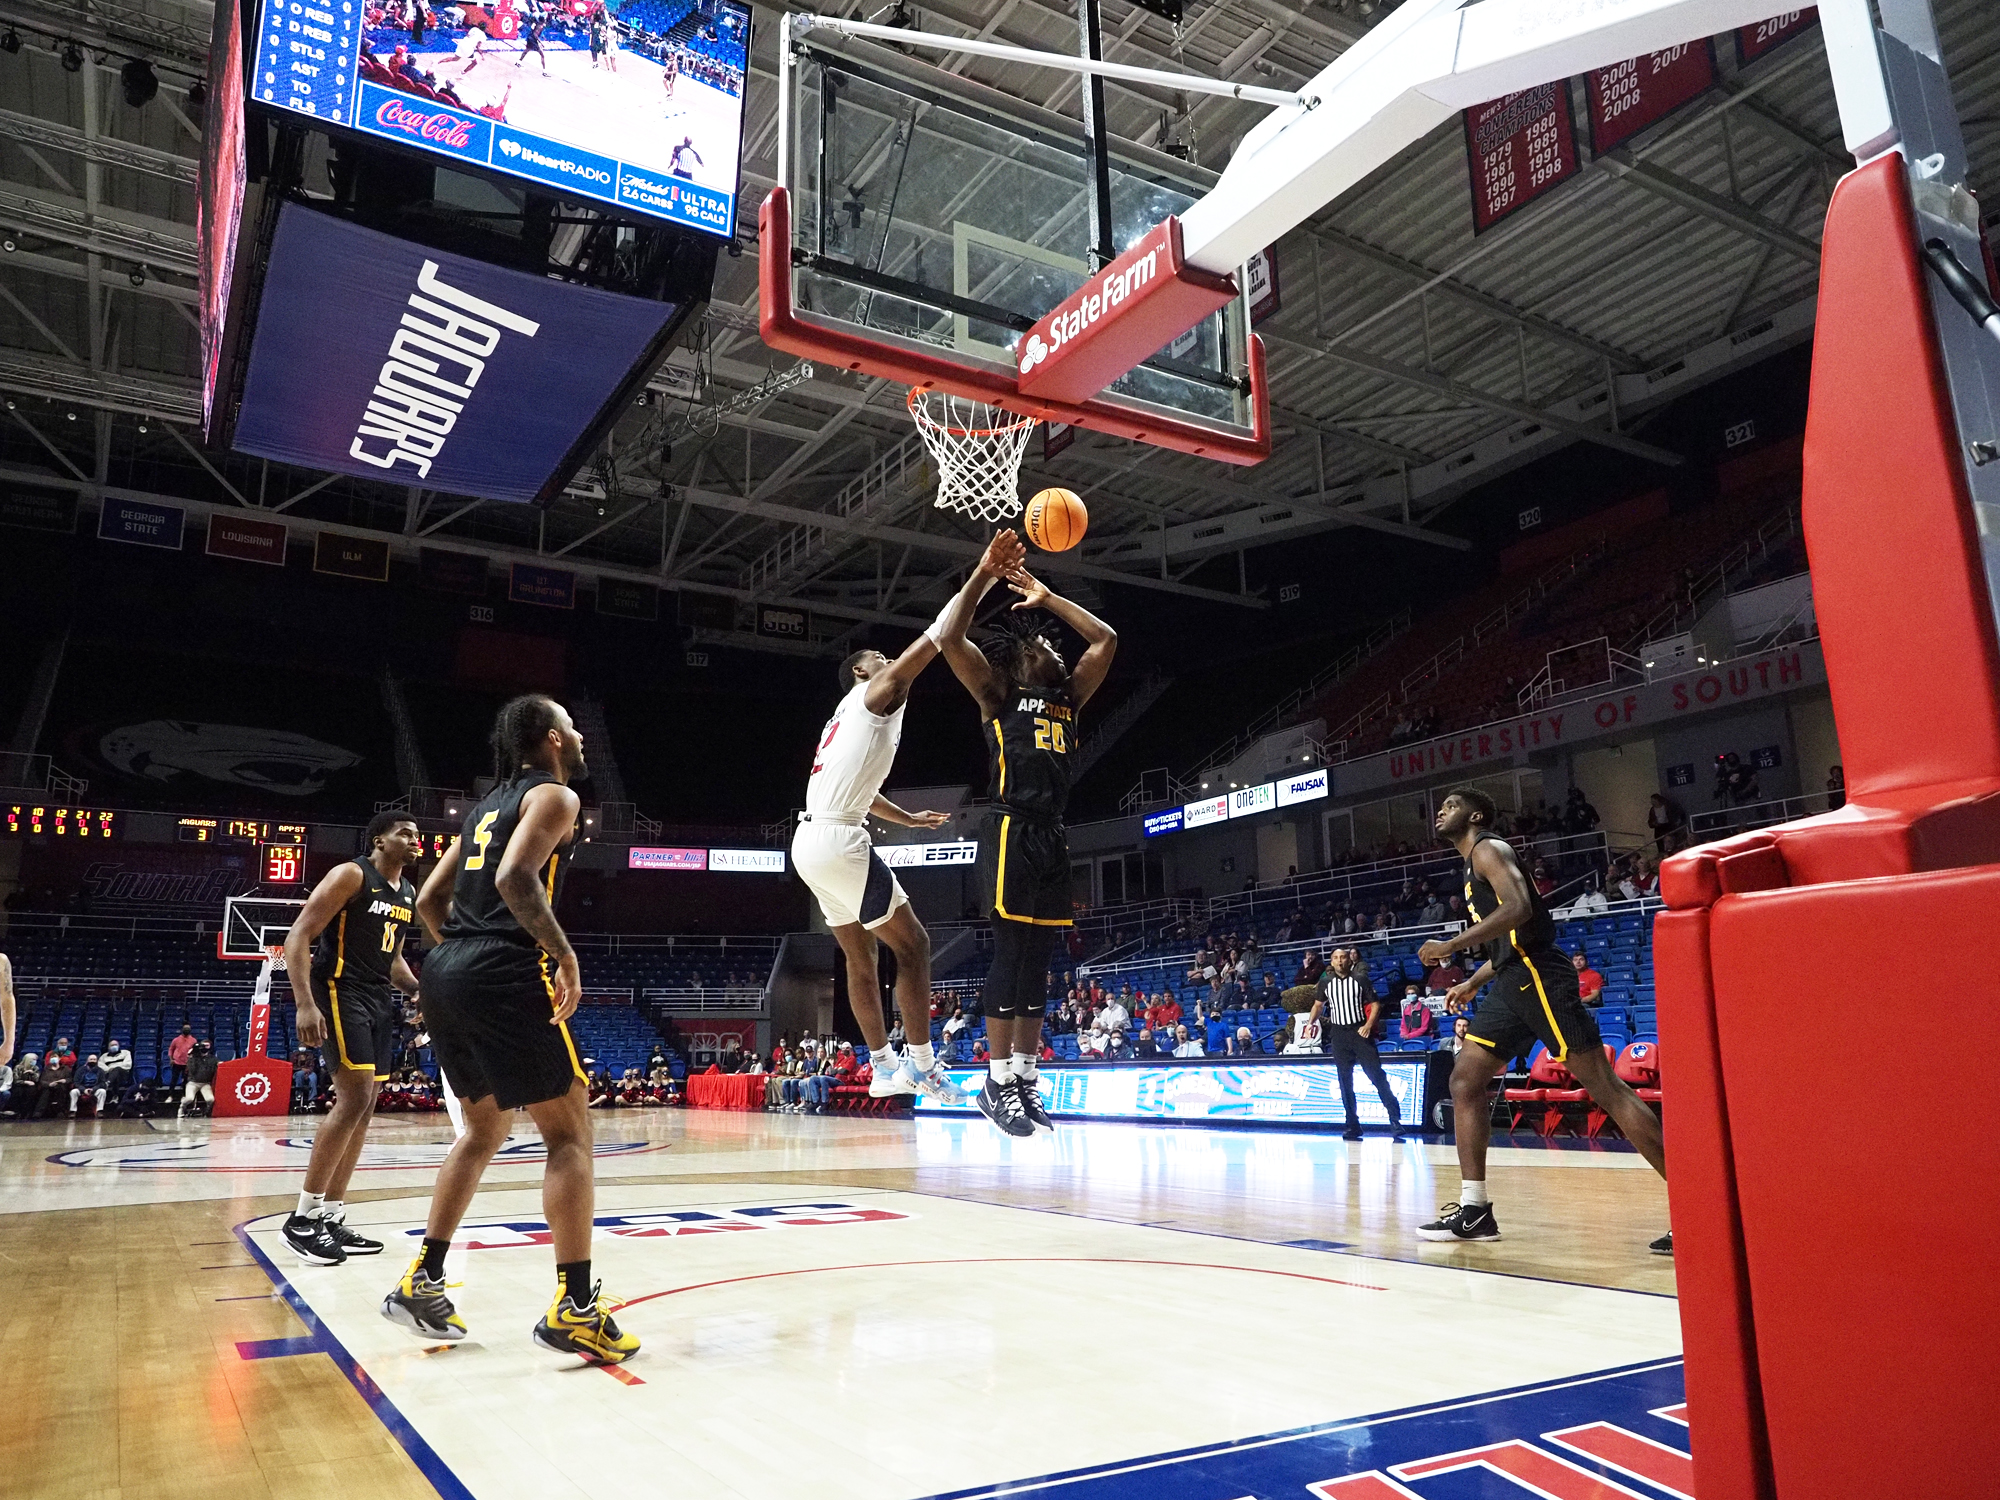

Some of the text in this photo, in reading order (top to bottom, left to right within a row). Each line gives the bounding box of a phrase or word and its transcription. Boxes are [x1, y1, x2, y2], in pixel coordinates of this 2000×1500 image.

[290, 2, 302, 15] O
[305, 7, 334, 26] REB
[342, 1, 352, 13] 0
[272, 15, 282, 28] 2
[344, 20, 351, 31] 1
[289, 20, 333, 43] D REB
[270, 34, 280, 46] 0
[340, 36, 349, 48] 3
[290, 41, 326, 61] STLS
[1652, 42, 1690, 75] 2007
[270, 53, 277, 65] 1
[338, 55, 347, 67] 0
[291, 61, 320, 78] AST
[1601, 57, 1638, 91] 2000
[265, 72, 275, 84] 0
[336, 74, 345, 86] 0
[264, 88, 274, 100] 0
[291, 80, 312, 95] TO
[1602, 72, 1639, 107] 2006
[289, 97, 316, 114] FLS
[336, 93, 343, 105] 1
[1603, 88, 1642, 124] 2008
[332, 109, 341, 121] 0
[1475, 82, 1558, 143] CONFERENCE
[376, 99, 476, 149] Coca-Cola
[1480, 93, 1556, 156] CHAMPIONS
[1525, 111, 1556, 142] 1980
[1527, 127, 1558, 157] 1989
[1483, 141, 1512, 171] 1979
[1528, 142, 1559, 173] 1991
[521, 147, 611, 184] iHeartRADIO
[1484, 156, 1513, 186] 1981
[1530, 158, 1562, 188] 1998
[1486, 171, 1515, 200] 1990
[680, 189, 728, 214] ULTRA
[1488, 186, 1516, 216] 1997
[700, 209, 726, 226] CALS
[350, 259, 541, 480] JAGUARS
[1727, 424, 1754, 444] 321
[120, 508, 165, 525] GEORGIA
[1520, 509, 1540, 527] 320
[124, 521, 160, 536] STATE
[222, 530, 273, 548] LOUISIANA
[1280, 586, 1299, 600] 319
[470, 606, 494, 621] 316
[687, 652, 708, 666] 317
[1390, 652, 1803, 778] UNIVERSITY OF SOUTH
[1034, 717, 1067, 754] 20
[1291, 776, 1326, 794] FAUSAK
[12, 806, 21, 815] 4
[33, 807, 45, 817] 10
[56, 809, 68, 818] 12
[76, 810, 91, 820] 21
[99, 812, 114, 822] 22
[1194, 804, 1217, 816] WARD
[7, 814, 16, 823] 0
[31, 815, 40, 825] 0
[55, 817, 63, 826] 0
[78, 819, 86, 828] 0
[101, 820, 110, 830] 0
[178, 818, 217, 828] JAGUARS
[10, 822, 18, 832] 3
[33, 824, 42, 833] 0
[56, 825, 66, 835] 0
[80, 827, 89, 836] 0
[103, 828, 112, 838] 0
[229, 821, 269, 838] 17:51
[198, 829, 207, 841] 3
[434, 835, 443, 843] 15
[464, 808, 500, 871] 5
[269, 848, 301, 860] 17:51
[731, 855, 782, 867] HEALTH
[925, 846, 975, 861] ESPN
[269, 859, 296, 880] 30
[380, 921, 399, 953] 11
[243, 1081, 263, 1097] pf
[1071, 1078, 1083, 1105] 3
[1145, 1078, 1157, 1106] 2
